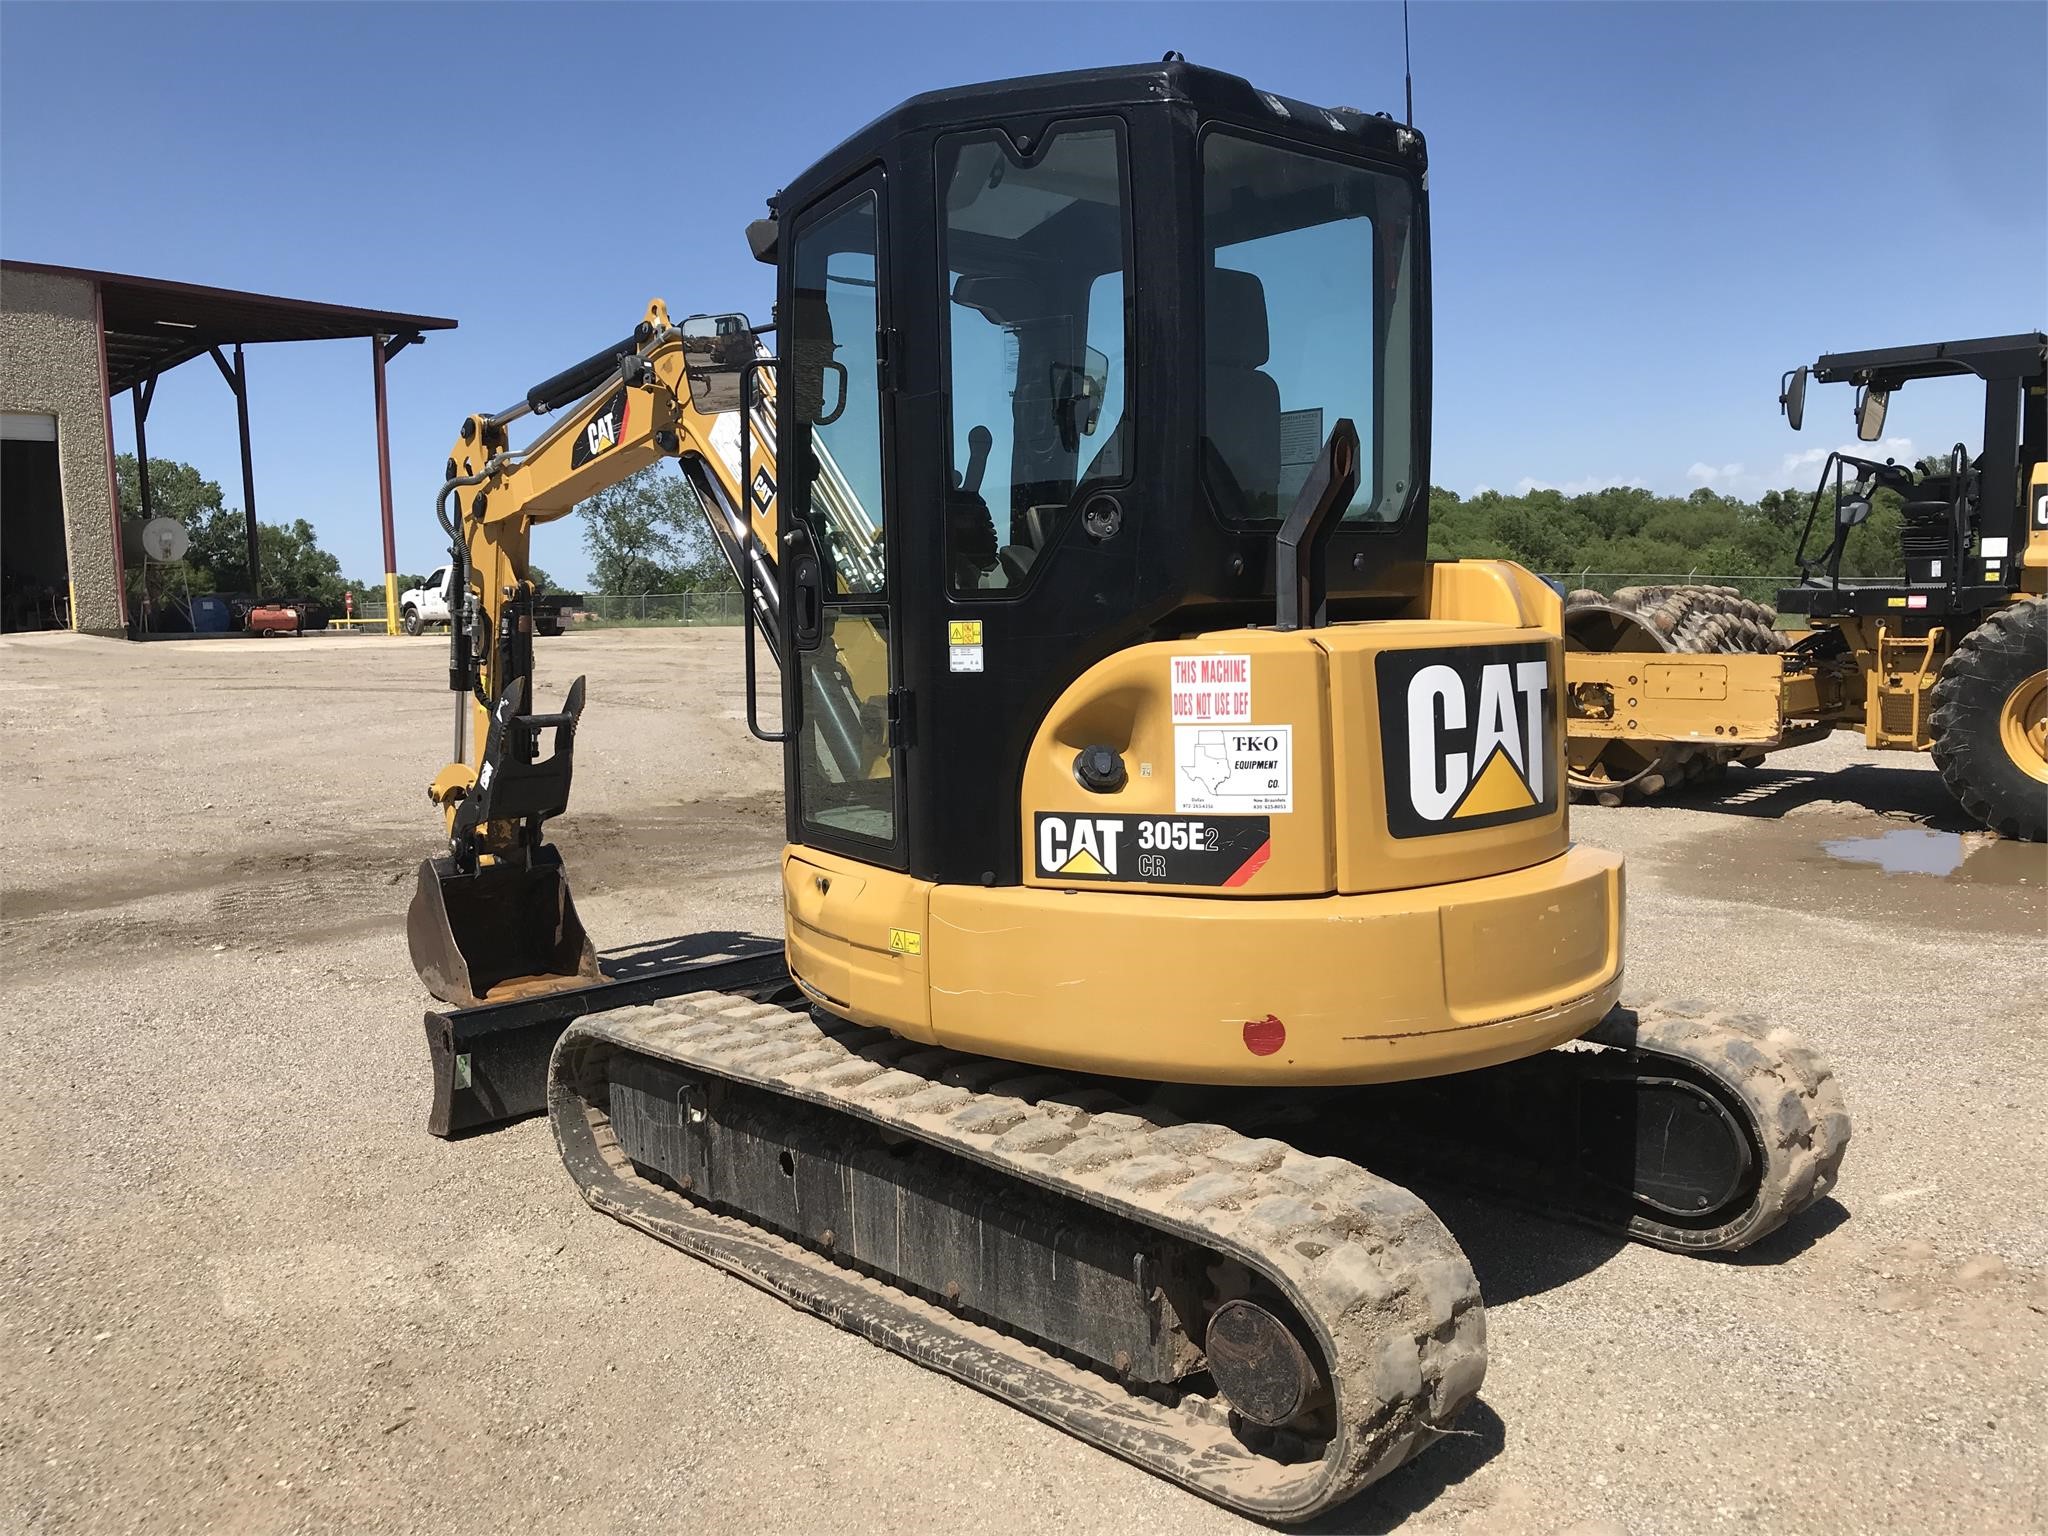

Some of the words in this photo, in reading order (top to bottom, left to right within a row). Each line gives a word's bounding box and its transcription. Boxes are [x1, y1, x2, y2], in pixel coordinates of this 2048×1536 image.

[587, 411, 616, 455] CAT
[753, 474, 774, 505] CAT
[1175, 660, 1197, 684] THIS
[1201, 659, 1247, 684] MACHINE
[1173, 692, 1193, 716] DOES
[1196, 692, 1212, 716] NOT
[1214, 691, 1231, 716] USE
[1234, 691, 1249, 715] DEF
[1232, 735, 1279, 752] T-K-O
[1407, 660, 1548, 821] CAT
[1234, 760, 1279, 770] EQUIPMENT
[1267, 779, 1280, 789] CO.
[1040, 817, 1124, 875] CAT
[1137, 820, 1220, 852] 305E2
[1138, 853, 1167, 877] CR
